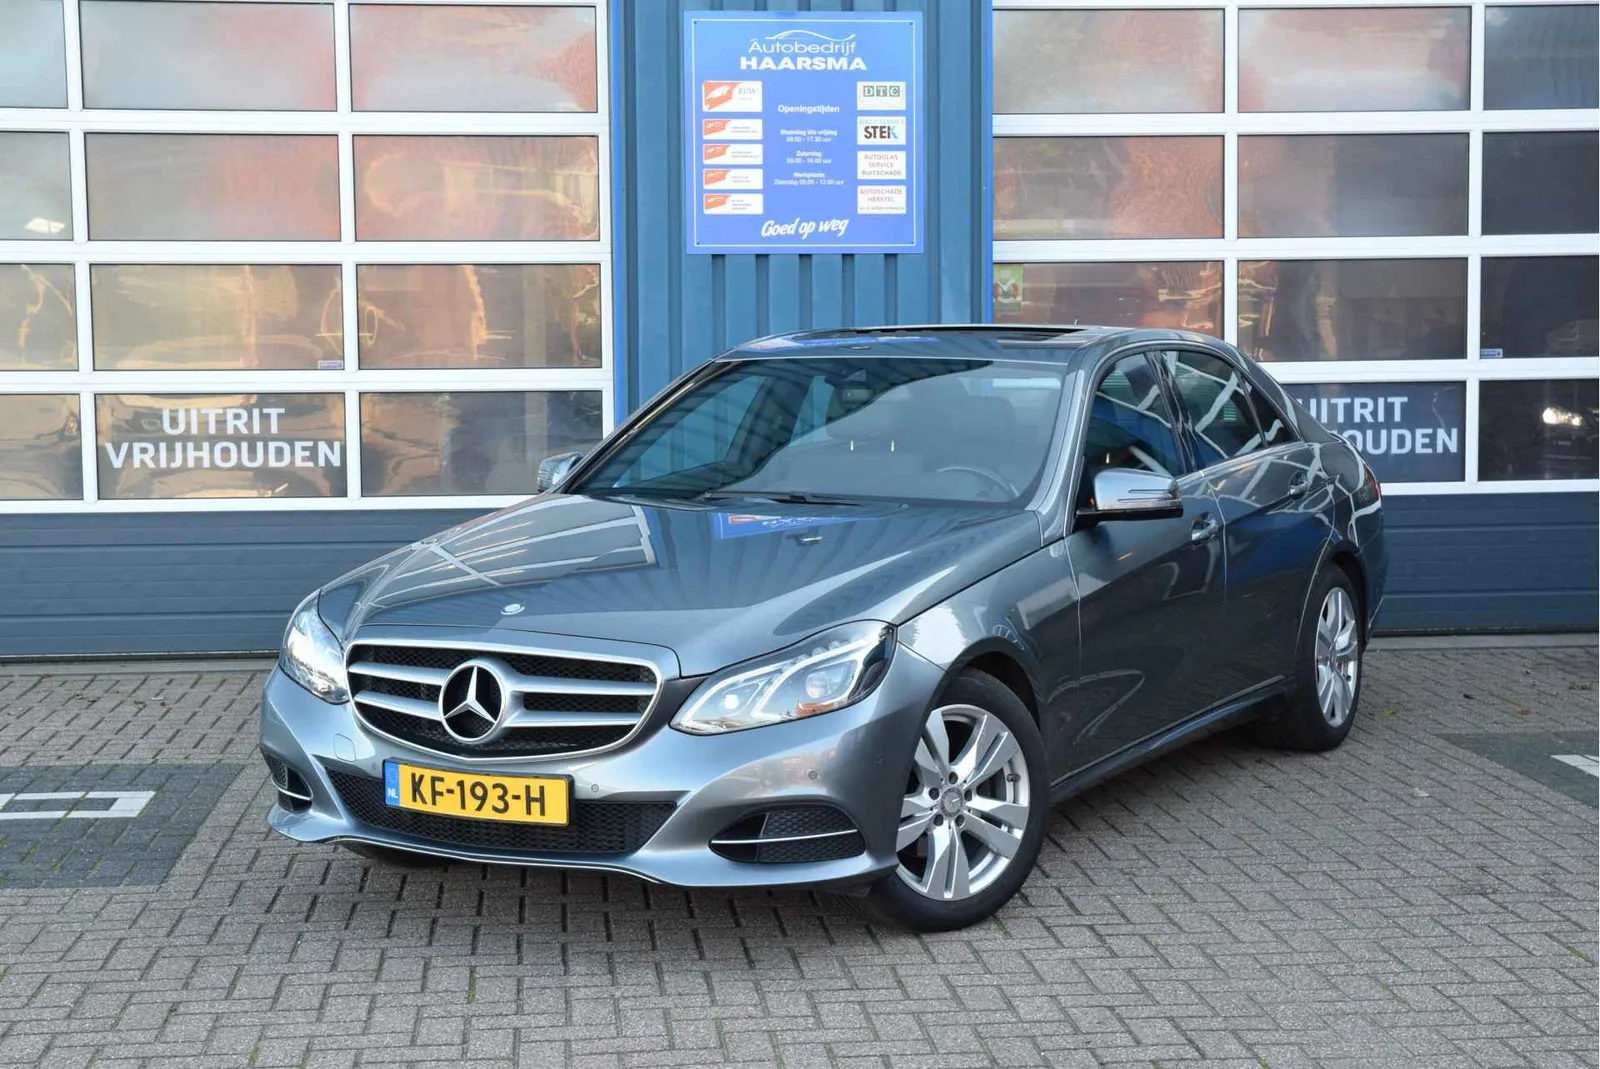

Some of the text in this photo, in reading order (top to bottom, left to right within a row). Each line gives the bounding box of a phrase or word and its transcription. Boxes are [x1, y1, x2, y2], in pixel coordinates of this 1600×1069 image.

[748, 41, 857, 55] Autobedrijf
[740, 56, 867, 70] HAARSMA
[863, 85, 900, 97] DTC
[778, 104, 840, 114] Openingstijden
[864, 125, 899, 139] STEK
[761, 217, 849, 239] Goed op weg
[162, 408, 285, 435] UITRIT
[105, 441, 341, 469] VRIJHOUDEN
[387, 788, 399, 799] NL
[410, 772, 546, 817] KF-193-H
